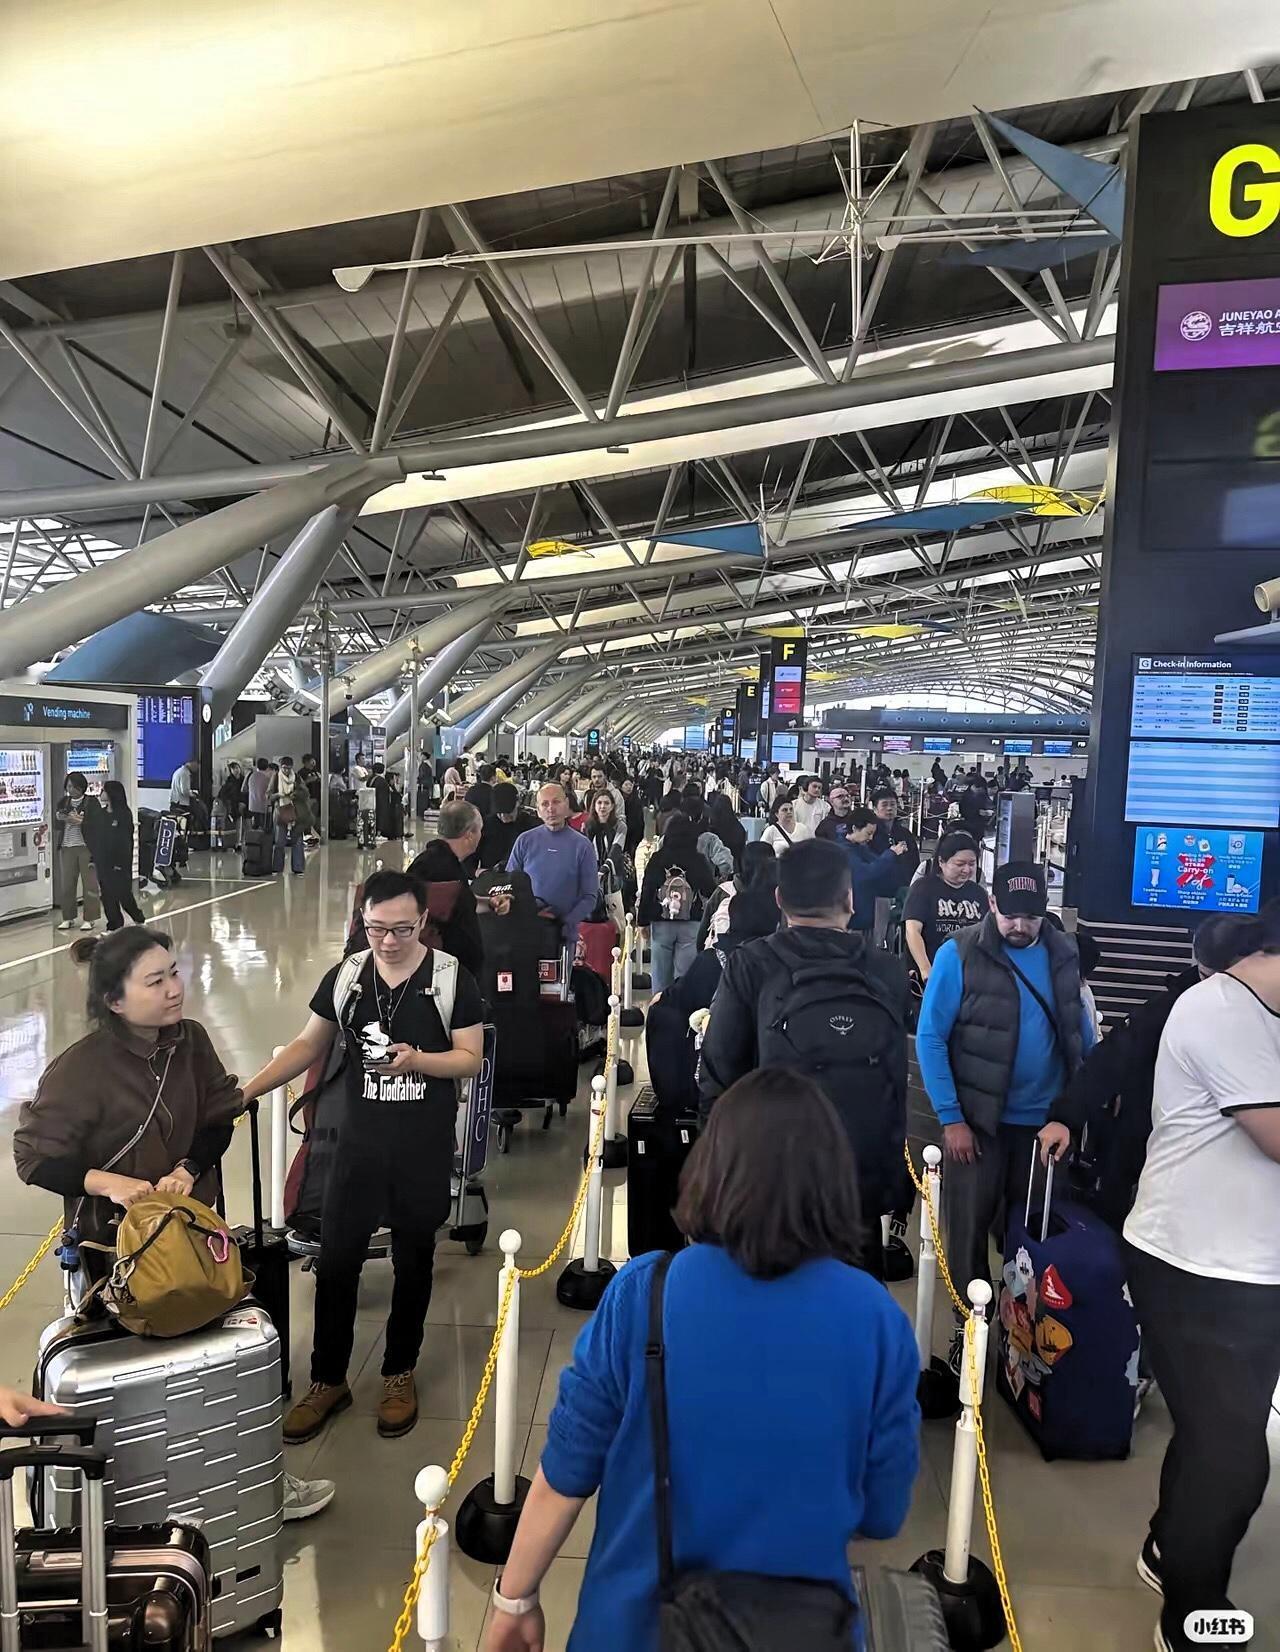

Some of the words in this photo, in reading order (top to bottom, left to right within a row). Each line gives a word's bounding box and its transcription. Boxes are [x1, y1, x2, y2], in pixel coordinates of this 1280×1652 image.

[1209, 143, 1280, 238] G
[1219, 309, 1273, 322] JUNEYAO
[783, 643, 796, 660] F
[1153, 660, 1185, 668] Check-in
[1186, 660, 1232, 669] Information
[747, 685, 756, 697] E
[42, 705, 67, 720] Vending
[67, 708, 91, 719] machine
[725, 709, 732, 717] D
[160, 829, 172, 856] DHC
[1177, 866, 1214, 875] Carry-on
[362, 1073, 378, 1099] The
[379, 1073, 427, 1101] Godfather
[475, 1057, 491, 1142] DHC
